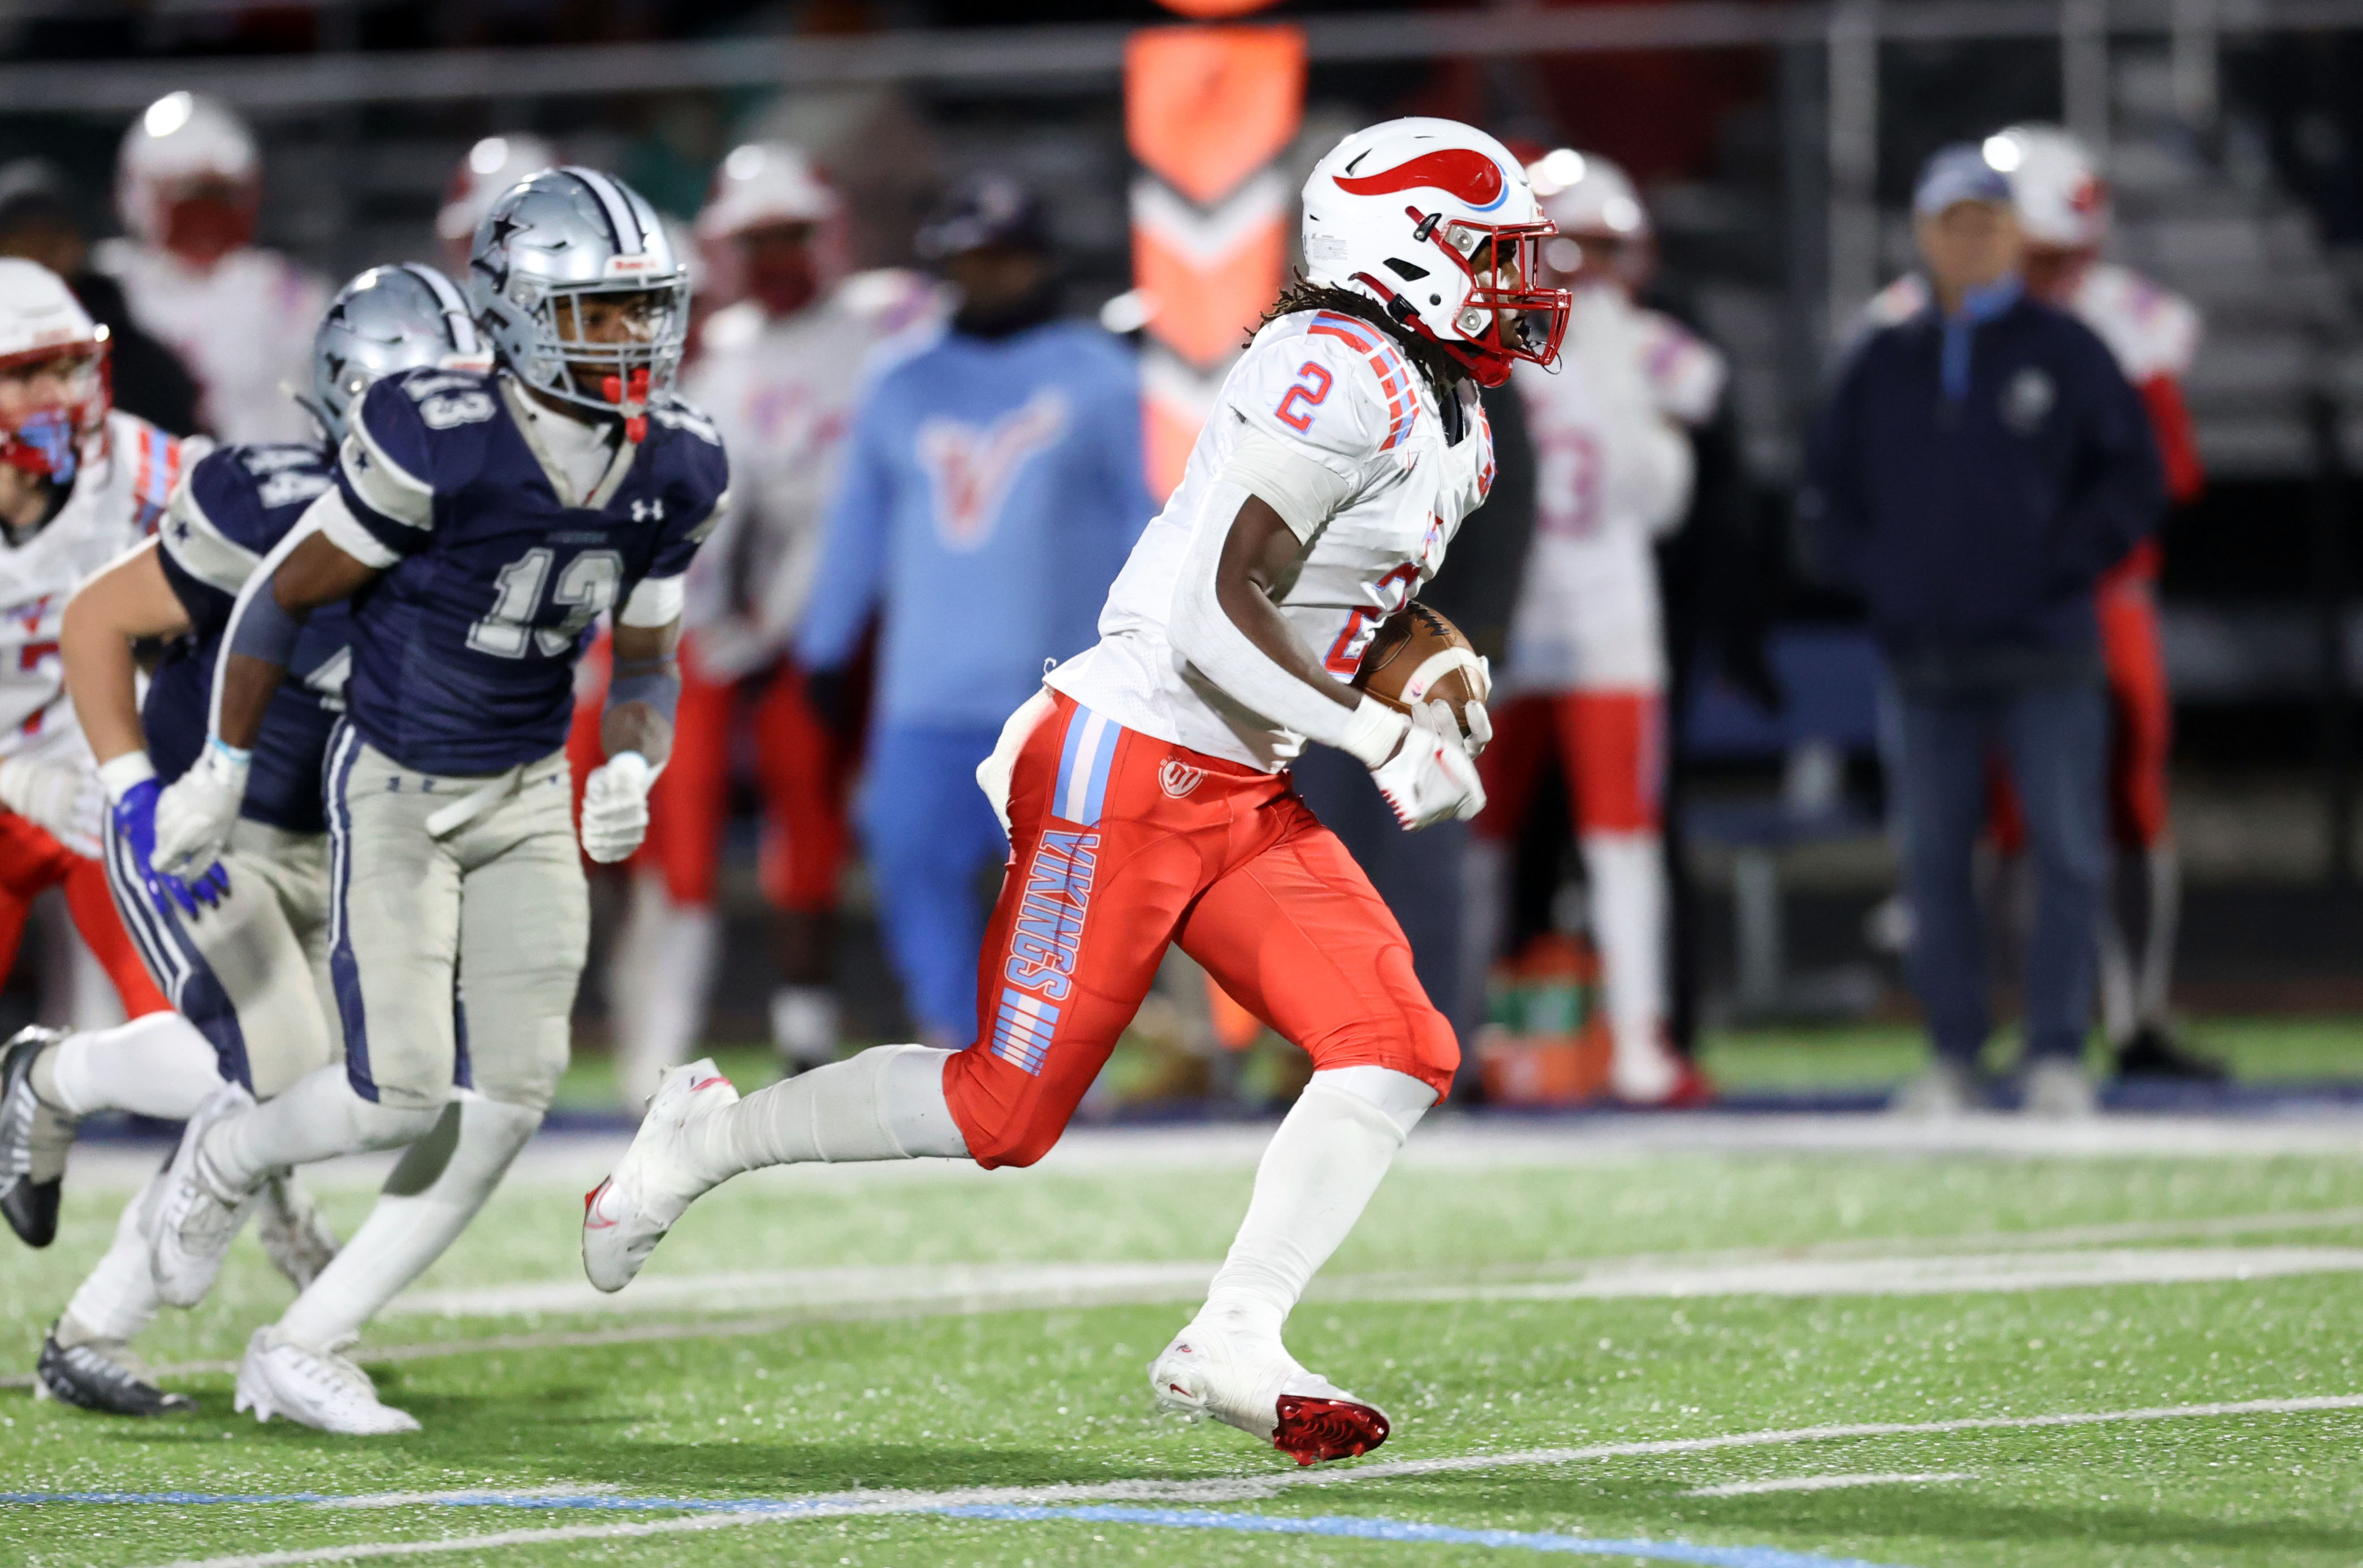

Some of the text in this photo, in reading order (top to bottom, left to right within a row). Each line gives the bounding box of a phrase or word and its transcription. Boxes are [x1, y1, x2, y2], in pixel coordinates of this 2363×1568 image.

[1273, 361, 1334, 436] 2
[465, 546, 624, 660] 13
[1004, 829, 1101, 1001] VIKINGS
